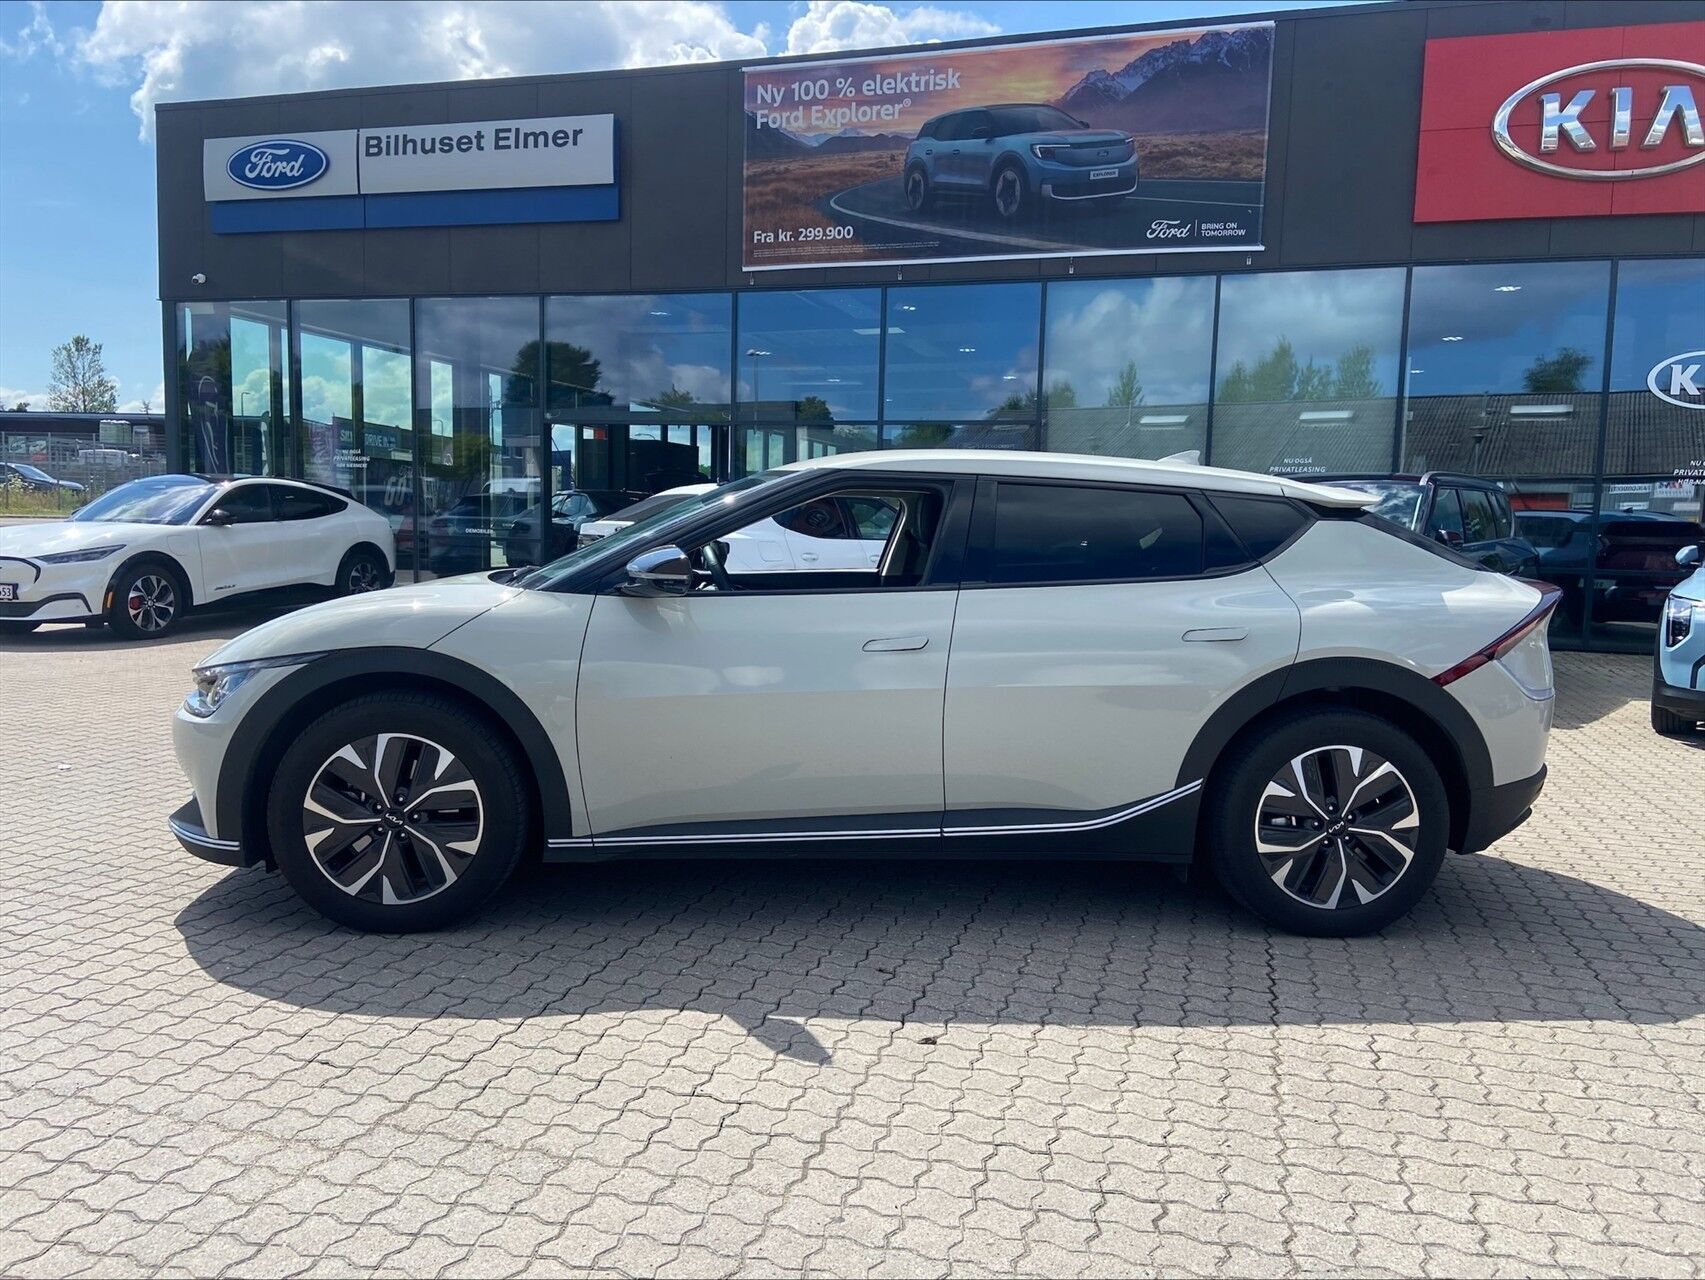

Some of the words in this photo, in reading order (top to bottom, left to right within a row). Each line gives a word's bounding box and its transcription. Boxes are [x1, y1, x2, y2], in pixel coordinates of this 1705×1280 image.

[757, 84, 785, 107] Ny
[792, 79, 829, 101] 100
[836, 77, 855, 98] %
[862, 68, 961, 96] elektrisk
[756, 105, 807, 129] Ford
[1538, 84, 1705, 153] KIA
[365, 130, 484, 157] Bilhuset
[494, 127, 583, 150] Elmer
[245, 148, 305, 178] Ford
[753, 230, 774, 243] Fra
[778, 228, 795, 242] kr.
[798, 225, 854, 241] 299.900
[1146, 219, 1192, 238] Ford
[1201, 222, 1224, 230] BRING
[1201, 229, 1247, 237] TOMORROW
[1294, 456, 1312, 464] OGSÅ
